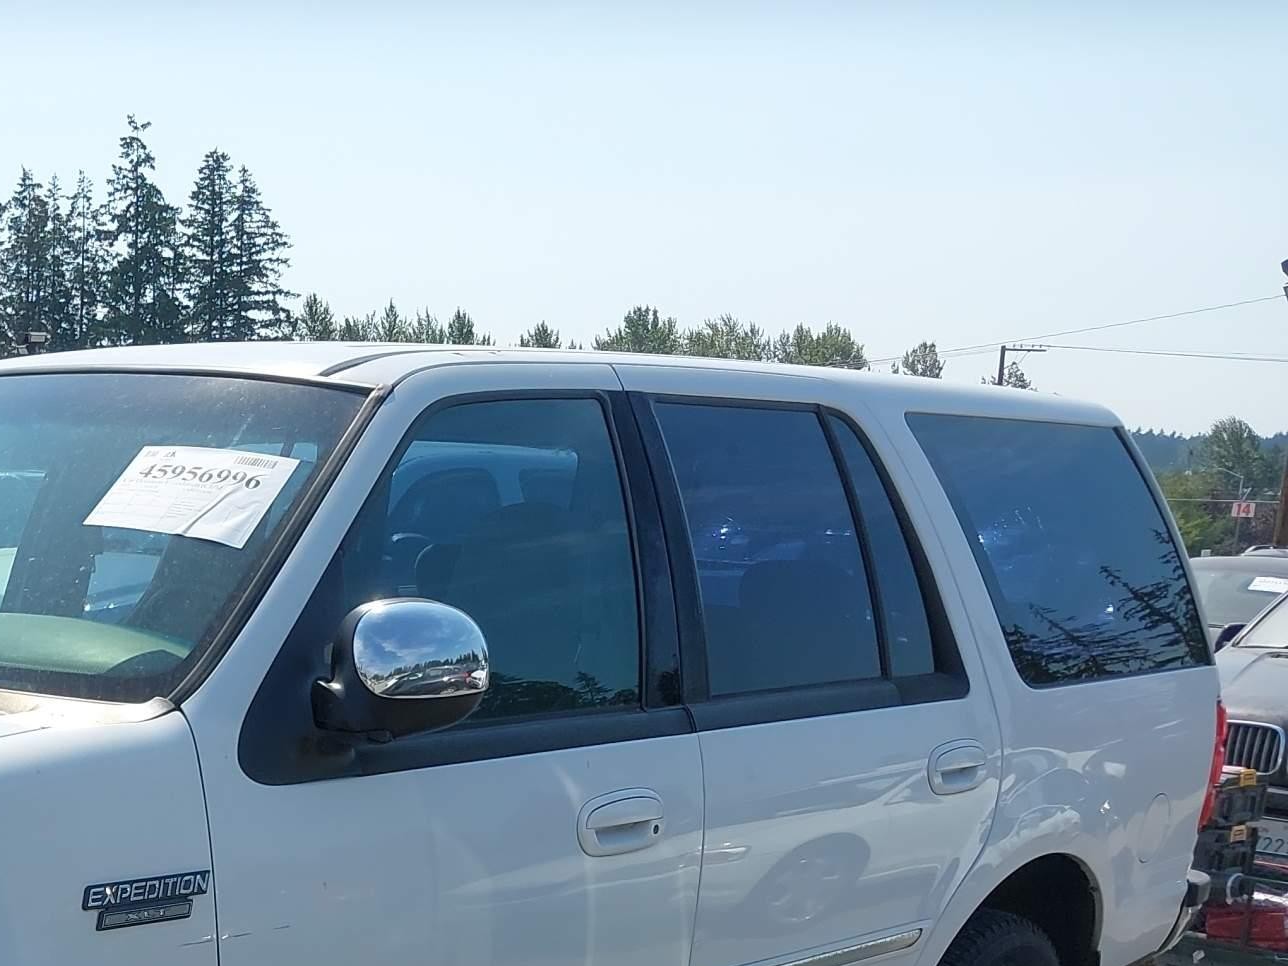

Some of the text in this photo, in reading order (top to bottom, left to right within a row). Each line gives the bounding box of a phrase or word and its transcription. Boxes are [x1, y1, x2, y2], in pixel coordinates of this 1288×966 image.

[139, 463, 269, 490] 45956996
[1236, 503, 1251, 517] 14
[87, 873, 210, 908] EXPEDITION
